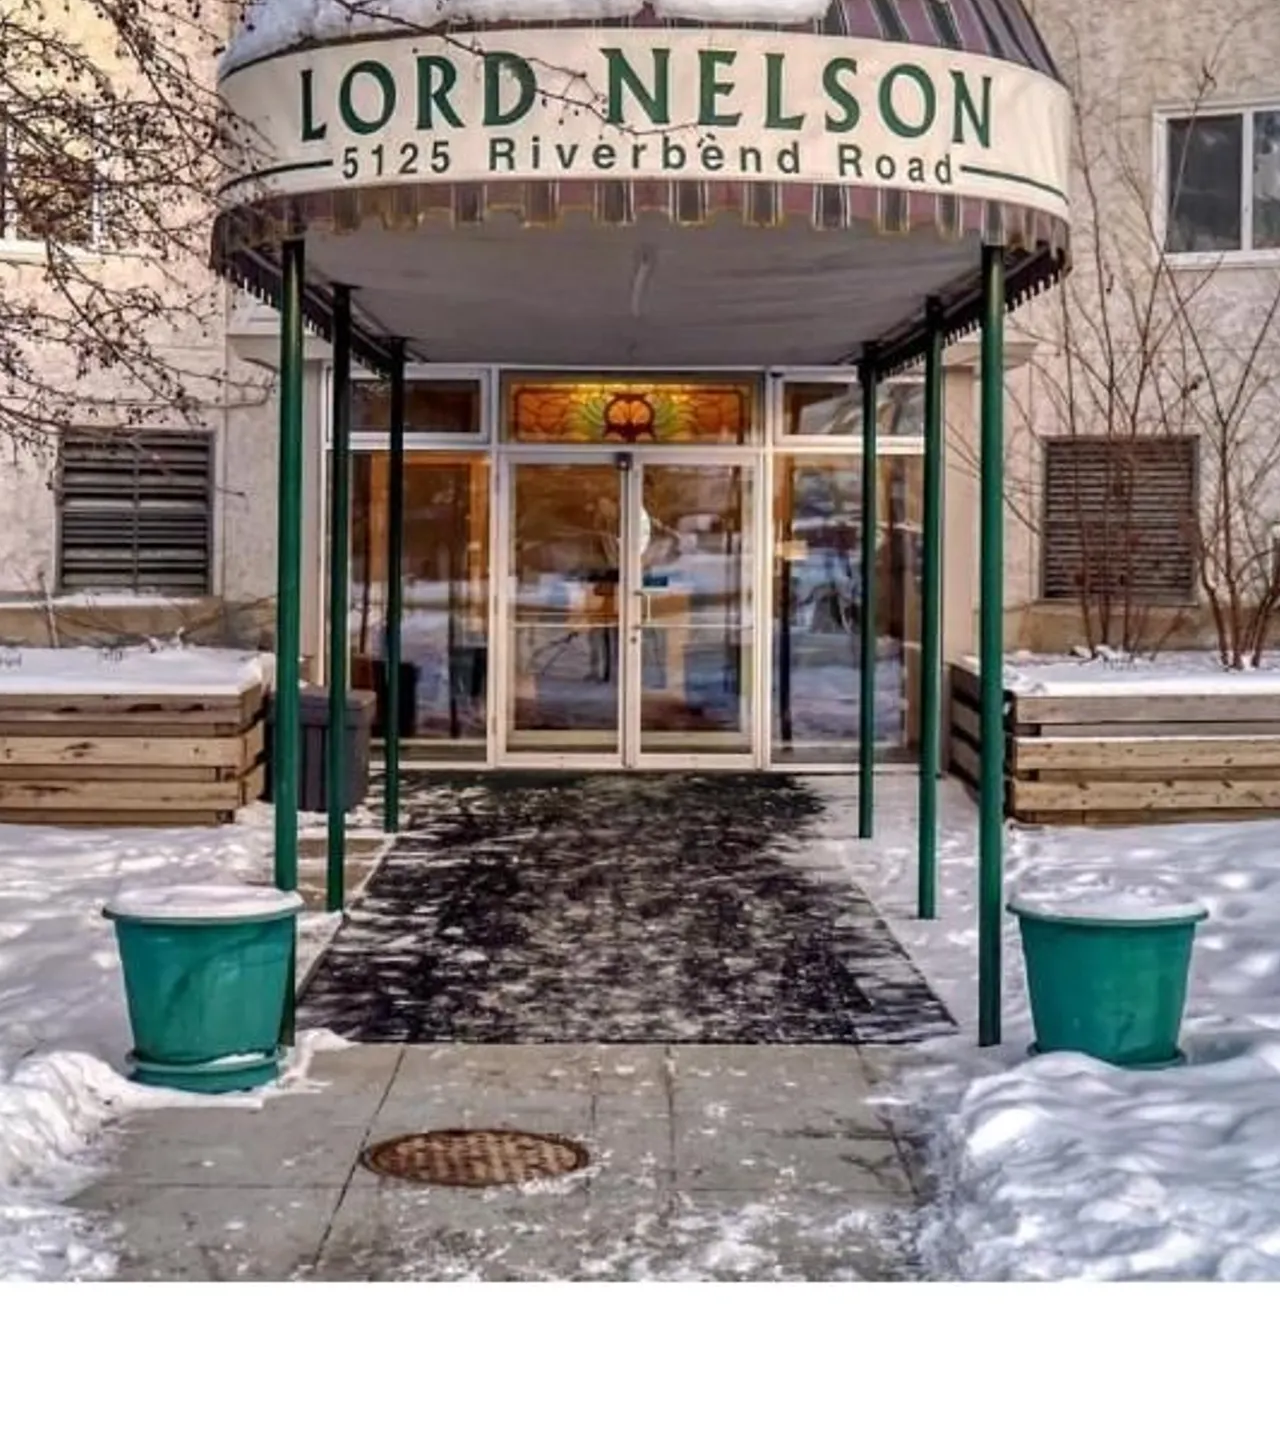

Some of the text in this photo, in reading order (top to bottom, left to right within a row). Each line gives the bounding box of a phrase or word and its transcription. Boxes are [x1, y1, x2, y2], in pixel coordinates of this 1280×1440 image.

[300, 47, 992, 148] LORD NELSON
[342, 135, 955, 184] 5125 Riverbend Road
